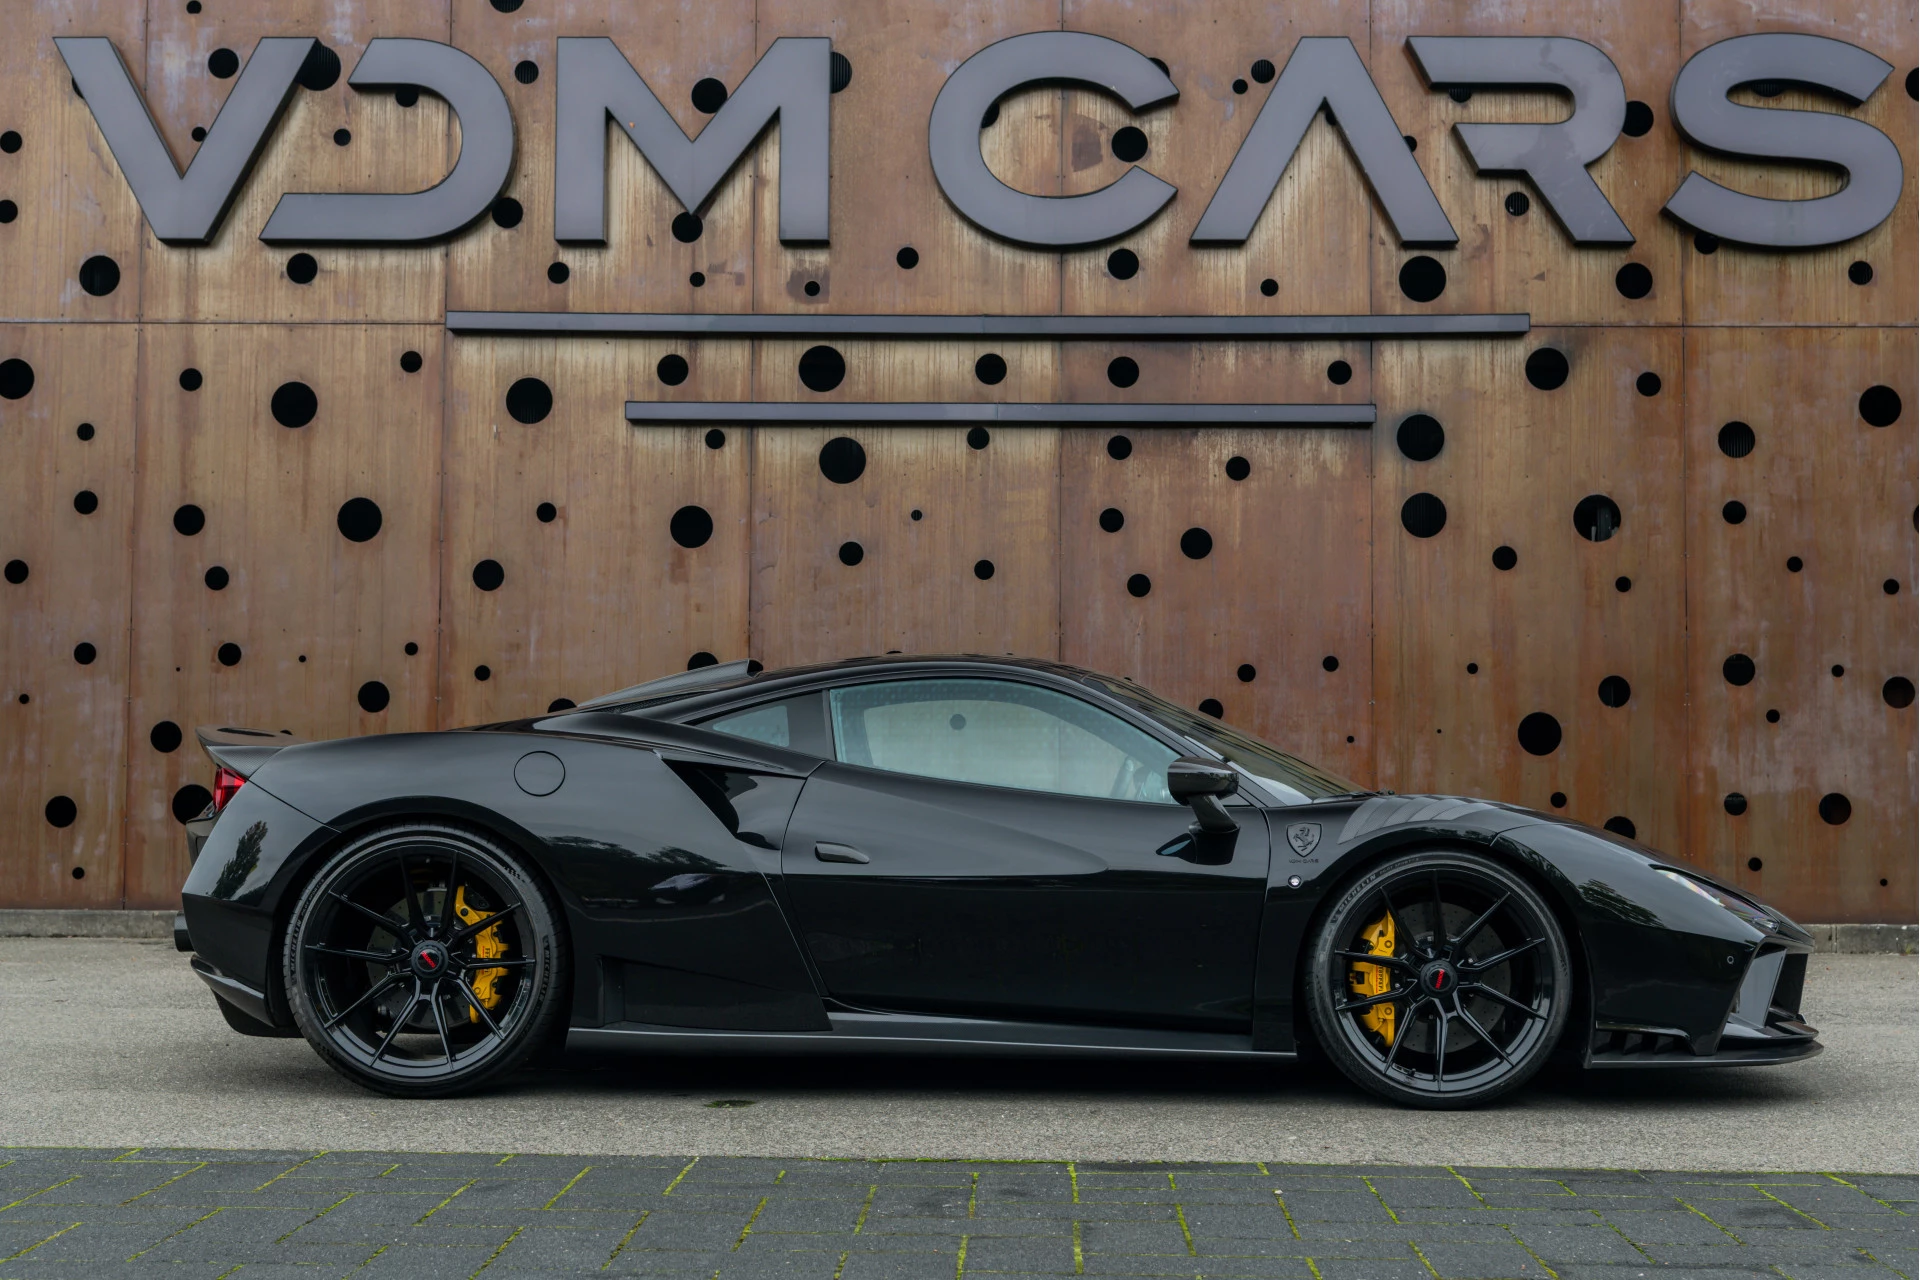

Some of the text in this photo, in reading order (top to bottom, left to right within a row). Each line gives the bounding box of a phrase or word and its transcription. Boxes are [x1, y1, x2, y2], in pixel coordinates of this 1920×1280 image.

[52, 30, 1904, 251] VDM CARS
[1338, 873, 1377, 912] MICHELIN
[290, 919, 302, 972] MICHELIN
